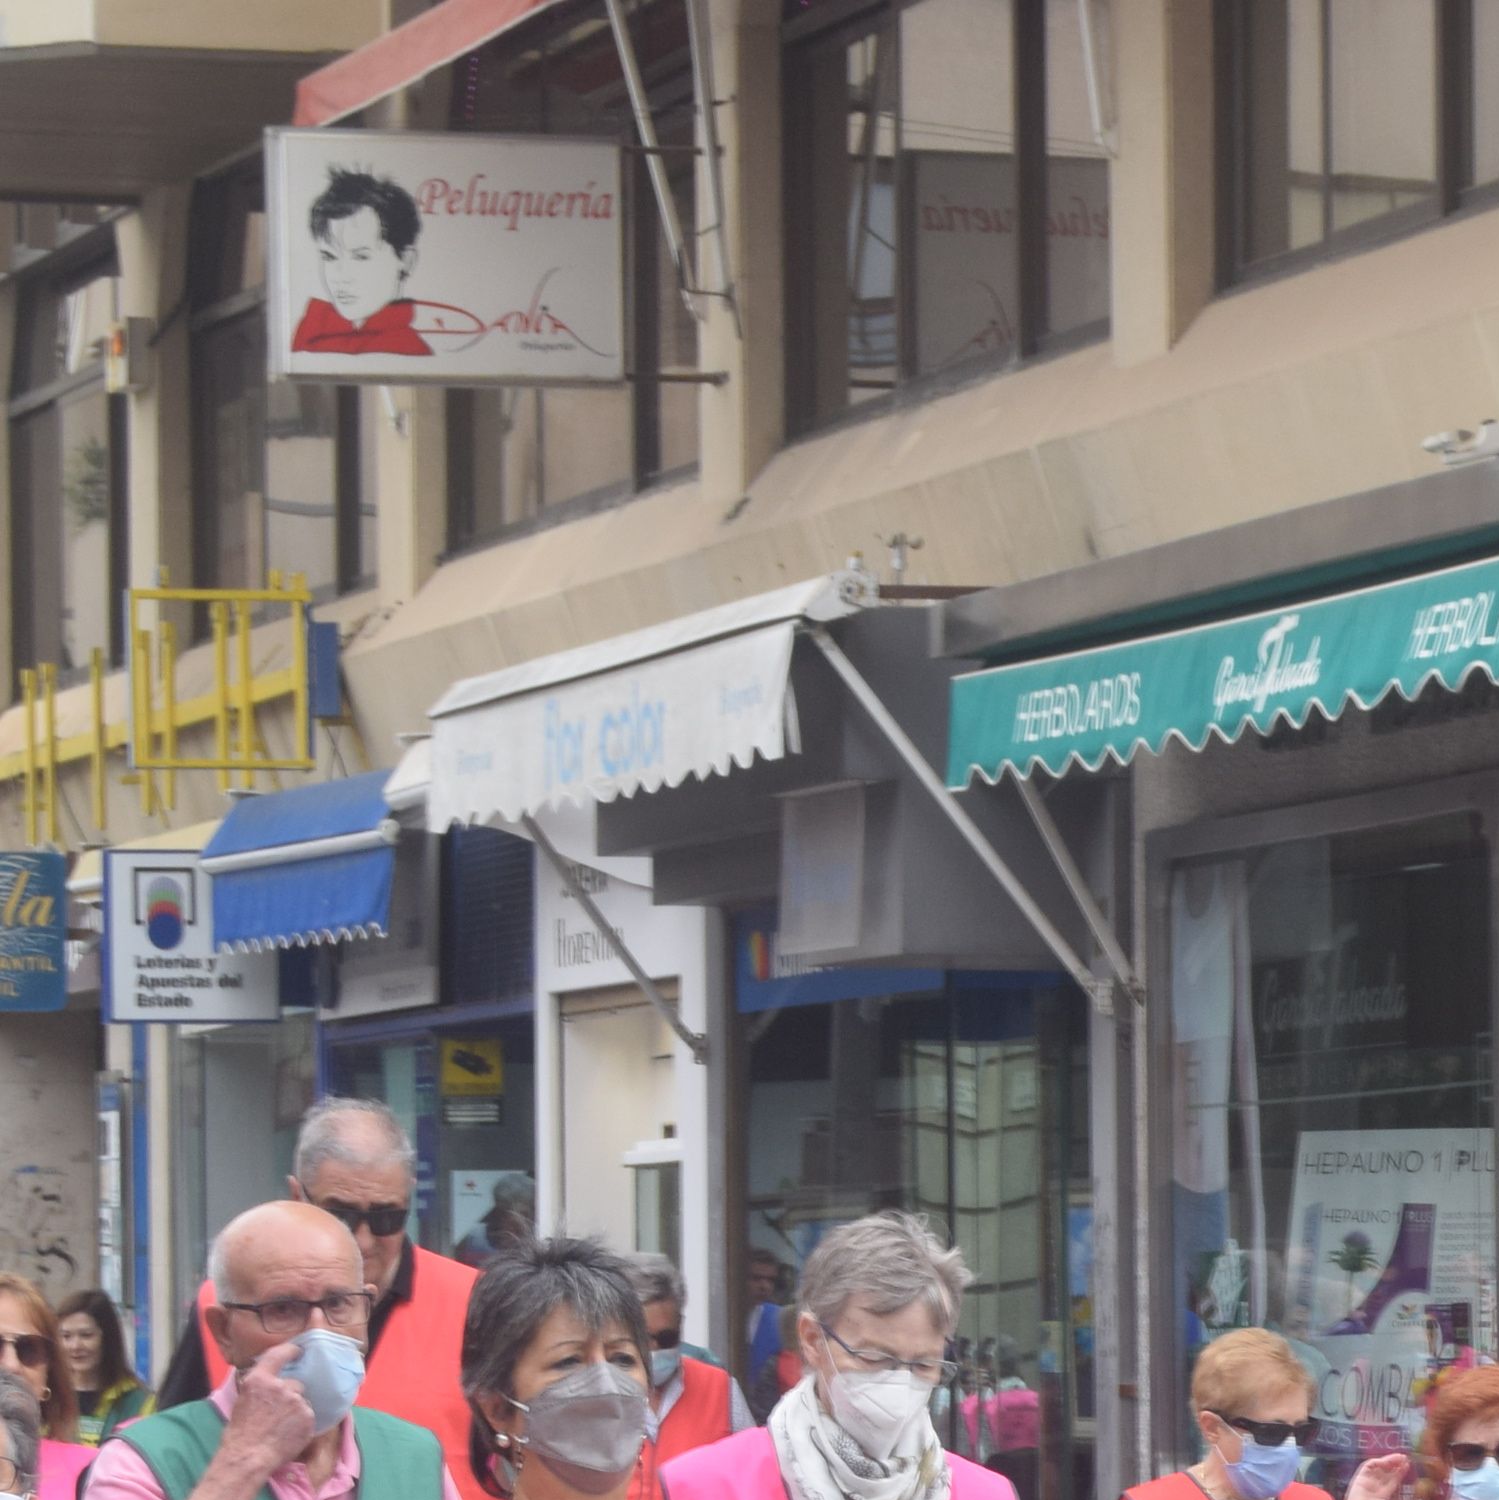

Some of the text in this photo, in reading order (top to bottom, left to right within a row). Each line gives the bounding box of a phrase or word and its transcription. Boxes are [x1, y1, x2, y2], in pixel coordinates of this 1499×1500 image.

[417, 174, 615, 231] Peluquería
[1013, 673, 1142, 742] HERBOLARIOS
[207, 957, 218, 973] y
[137, 974, 243, 990] Apuestas del
[136, 993, 193, 1007] Estado
[1304, 1150, 1424, 1175] HEPAUNO
[1322, 1207, 1391, 1225] HEPAUNO
